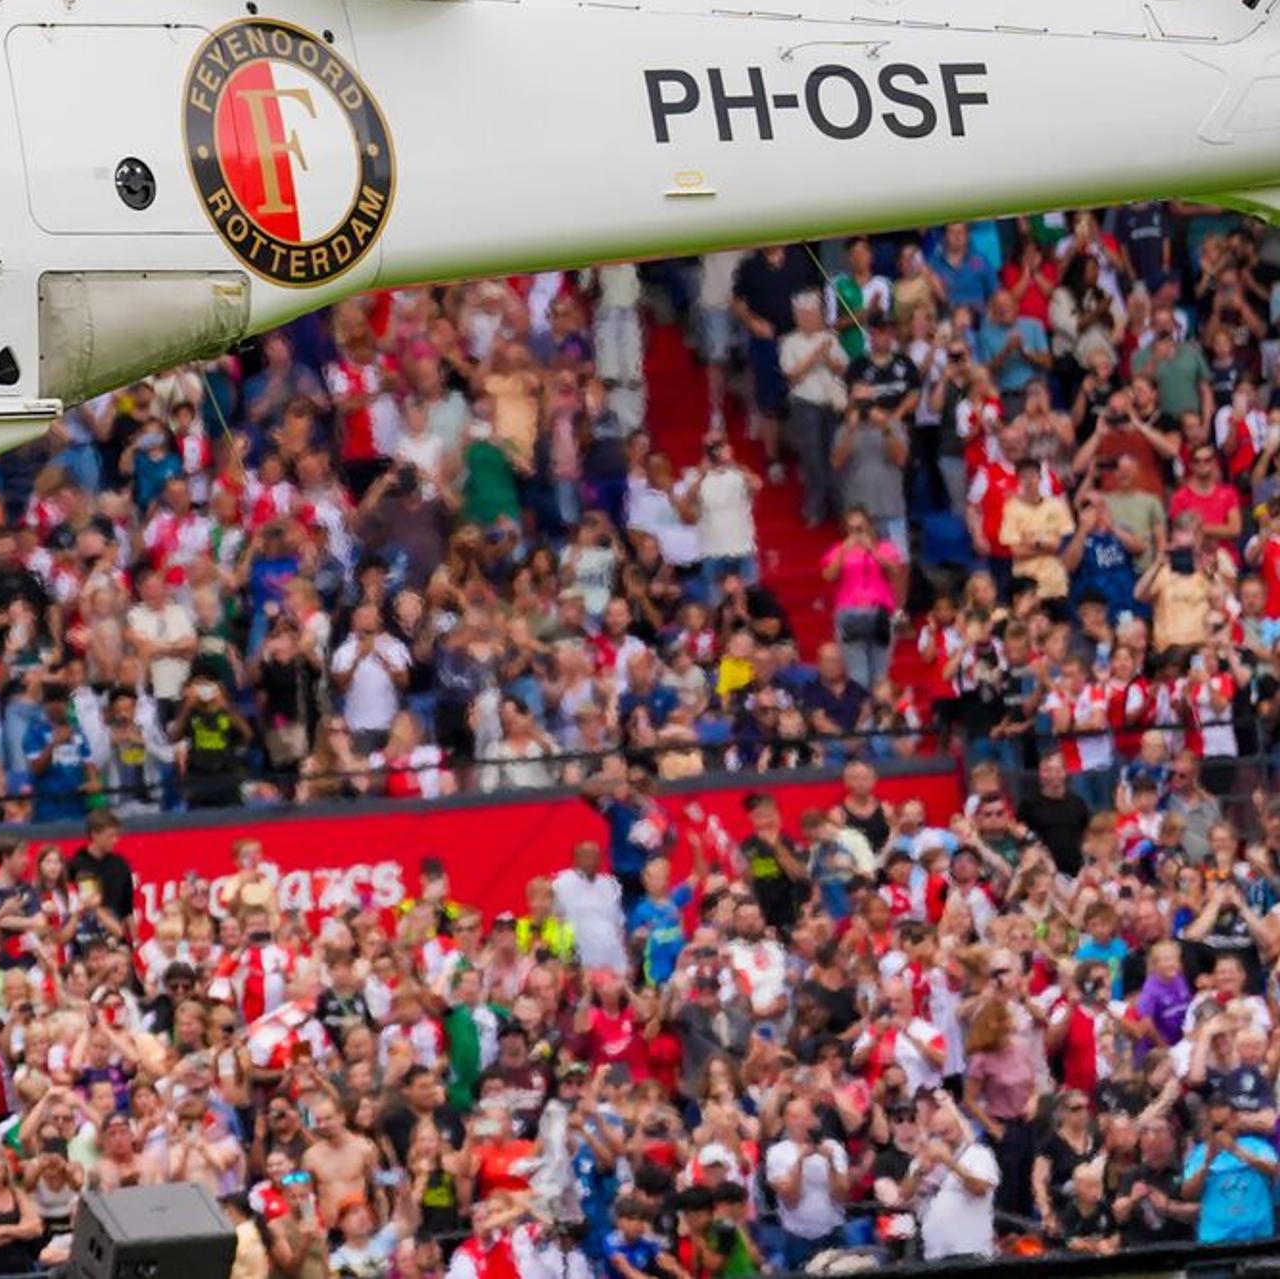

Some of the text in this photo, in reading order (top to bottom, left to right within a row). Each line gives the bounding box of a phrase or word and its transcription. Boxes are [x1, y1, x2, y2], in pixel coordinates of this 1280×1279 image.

[190, 27, 364, 114] FEYENOORD
[643, 62, 989, 143] PH-OSF
[208, 184, 386, 278] ROTTERDAM
